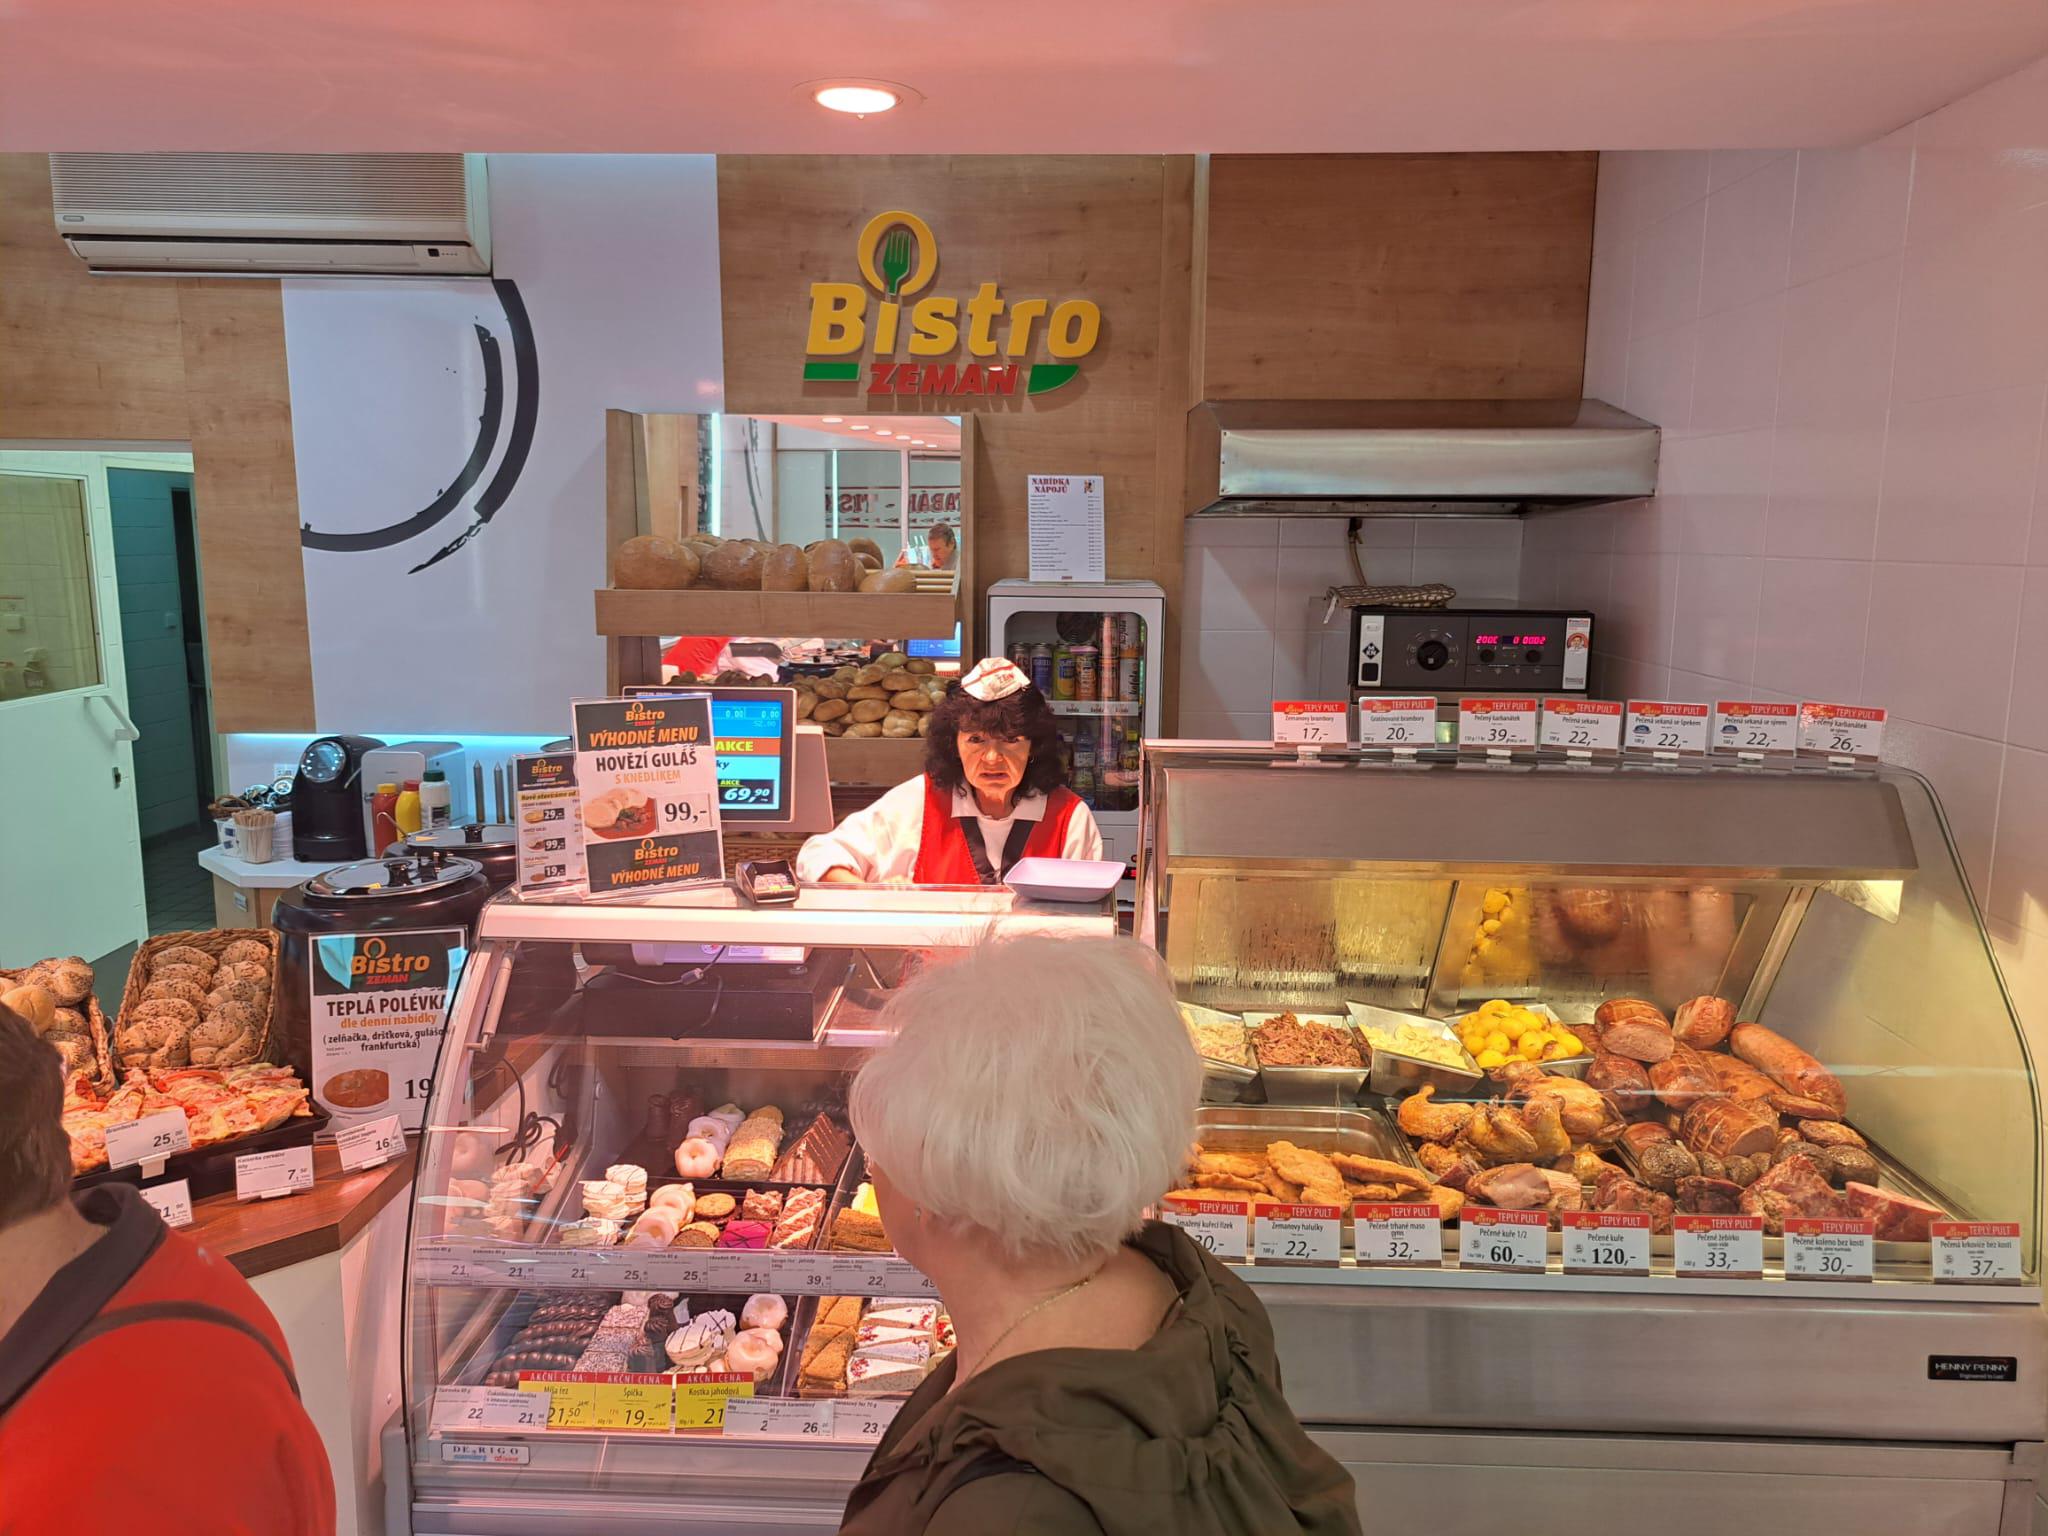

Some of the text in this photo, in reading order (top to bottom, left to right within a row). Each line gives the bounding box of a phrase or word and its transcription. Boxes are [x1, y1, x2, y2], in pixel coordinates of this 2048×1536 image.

[806, 210, 1101, 358] Bistro
[866, 362, 1020, 396] ZEMAN
[1304, 703, 1322, 711] TEPLÝ
[1392, 700, 1427, 708] TEPLÝ PULT
[1492, 701, 1528, 710] TEPLÝ PULT
[1576, 703, 1614, 713] TEPLÝ PULT
[1662, 705, 1700, 715] TEPLÝ PULT
[1751, 705, 1789, 714] TEPLÝ PULT
[625, 702, 665, 721] Bistro
[1836, 708, 1876, 720] TEPLÝ PULT
[590, 726, 699, 748] VÝHODNÉ MENU
[1303, 727, 1328, 741] 17,-
[1386, 727, 1414, 741] 20,-
[1568, 731, 1598, 746] 22,-
[1746, 732, 1777, 747] 22,-
[715, 741, 754, 752] AKCE
[1657, 733, 1688, 748] 22,-
[1829, 736, 1862, 752] 26,-
[596, 747, 697, 772] HOVĚZÍ GULÁŠ
[531, 758, 563, 774] Bistro
[615, 769, 681, 785] S KNEDLÍKEM
[664, 802, 707, 823] 99,-
[634, 838, 678, 860] Bistro
[611, 863, 700, 885] VÝHODNÉ MENU
[351, 937, 430, 975] Bistro
[366, 974, 409, 985] ZEMAN
[326, 996, 376, 1017] TEPLÁ
[340, 1012, 438, 1029] dle denní nabídky
[361, 1039, 420, 1052] frankfurtská)
[1199, 1202, 1240, 1214] TEPLÝ PULT
[1292, 1206, 1333, 1218] TEPLÝ PULT
[1390, 1207, 1431, 1217] TEPLÝ PULT
[1498, 1212, 1539, 1223] TEPLÝ PULT
[1599, 1215, 1640, 1226] TEPLÝ PULT
[1712, 1218, 1752, 1229] TEPLÝ PULT
[1219, 1220, 1234, 1230] řízek
[1271, 1222, 1324, 1233] Zemanovy halušky
[1369, 1221, 1389, 1230] Pečené
[1390, 1222, 1408, 1231] trhané
[1822, 1222, 1864, 1233] TEPLÝ PULT
[1969, 1224, 2011, 1236] TEPLÝ PULT
[1479, 1227, 1527, 1239] Pečené kuře 1/2
[1587, 1233, 1624, 1242] Pečené kuře
[1697, 1233, 1739, 1242] Pečené žebírko
[1792, 1237, 1864, 1247] Pečené koleno bez kosti
[1961, 1240, 1986, 1249] krkovice
[1987, 1240, 2000, 1249] bez
[1998, 1240, 2012, 1249] kosti
[1285, 1240, 1318, 1258] 22,-
[1387, 1242, 1420, 1259] 32,-
[1490, 1246, 1524, 1264] 60,-
[1591, 1248, 1636, 1266] 120,-
[1705, 1252, 1738, 1269] 33,-
[1819, 1256, 1853, 1274] 30,-
[1970, 1260, 2005, 1278] 37,-
[1935, 1363, 2009, 1372] HENNY PENNY
[530, 1371, 558, 1382] AKČNÍ
[607, 1373, 634, 1384] AKČNÍ
[687, 1373, 714, 1383] AKČNÍ
[623, 1387, 643, 1398] Špička
[689, 1386, 740, 1397] Kostka jahodová
[625, 1409, 654, 1428] 19,-
